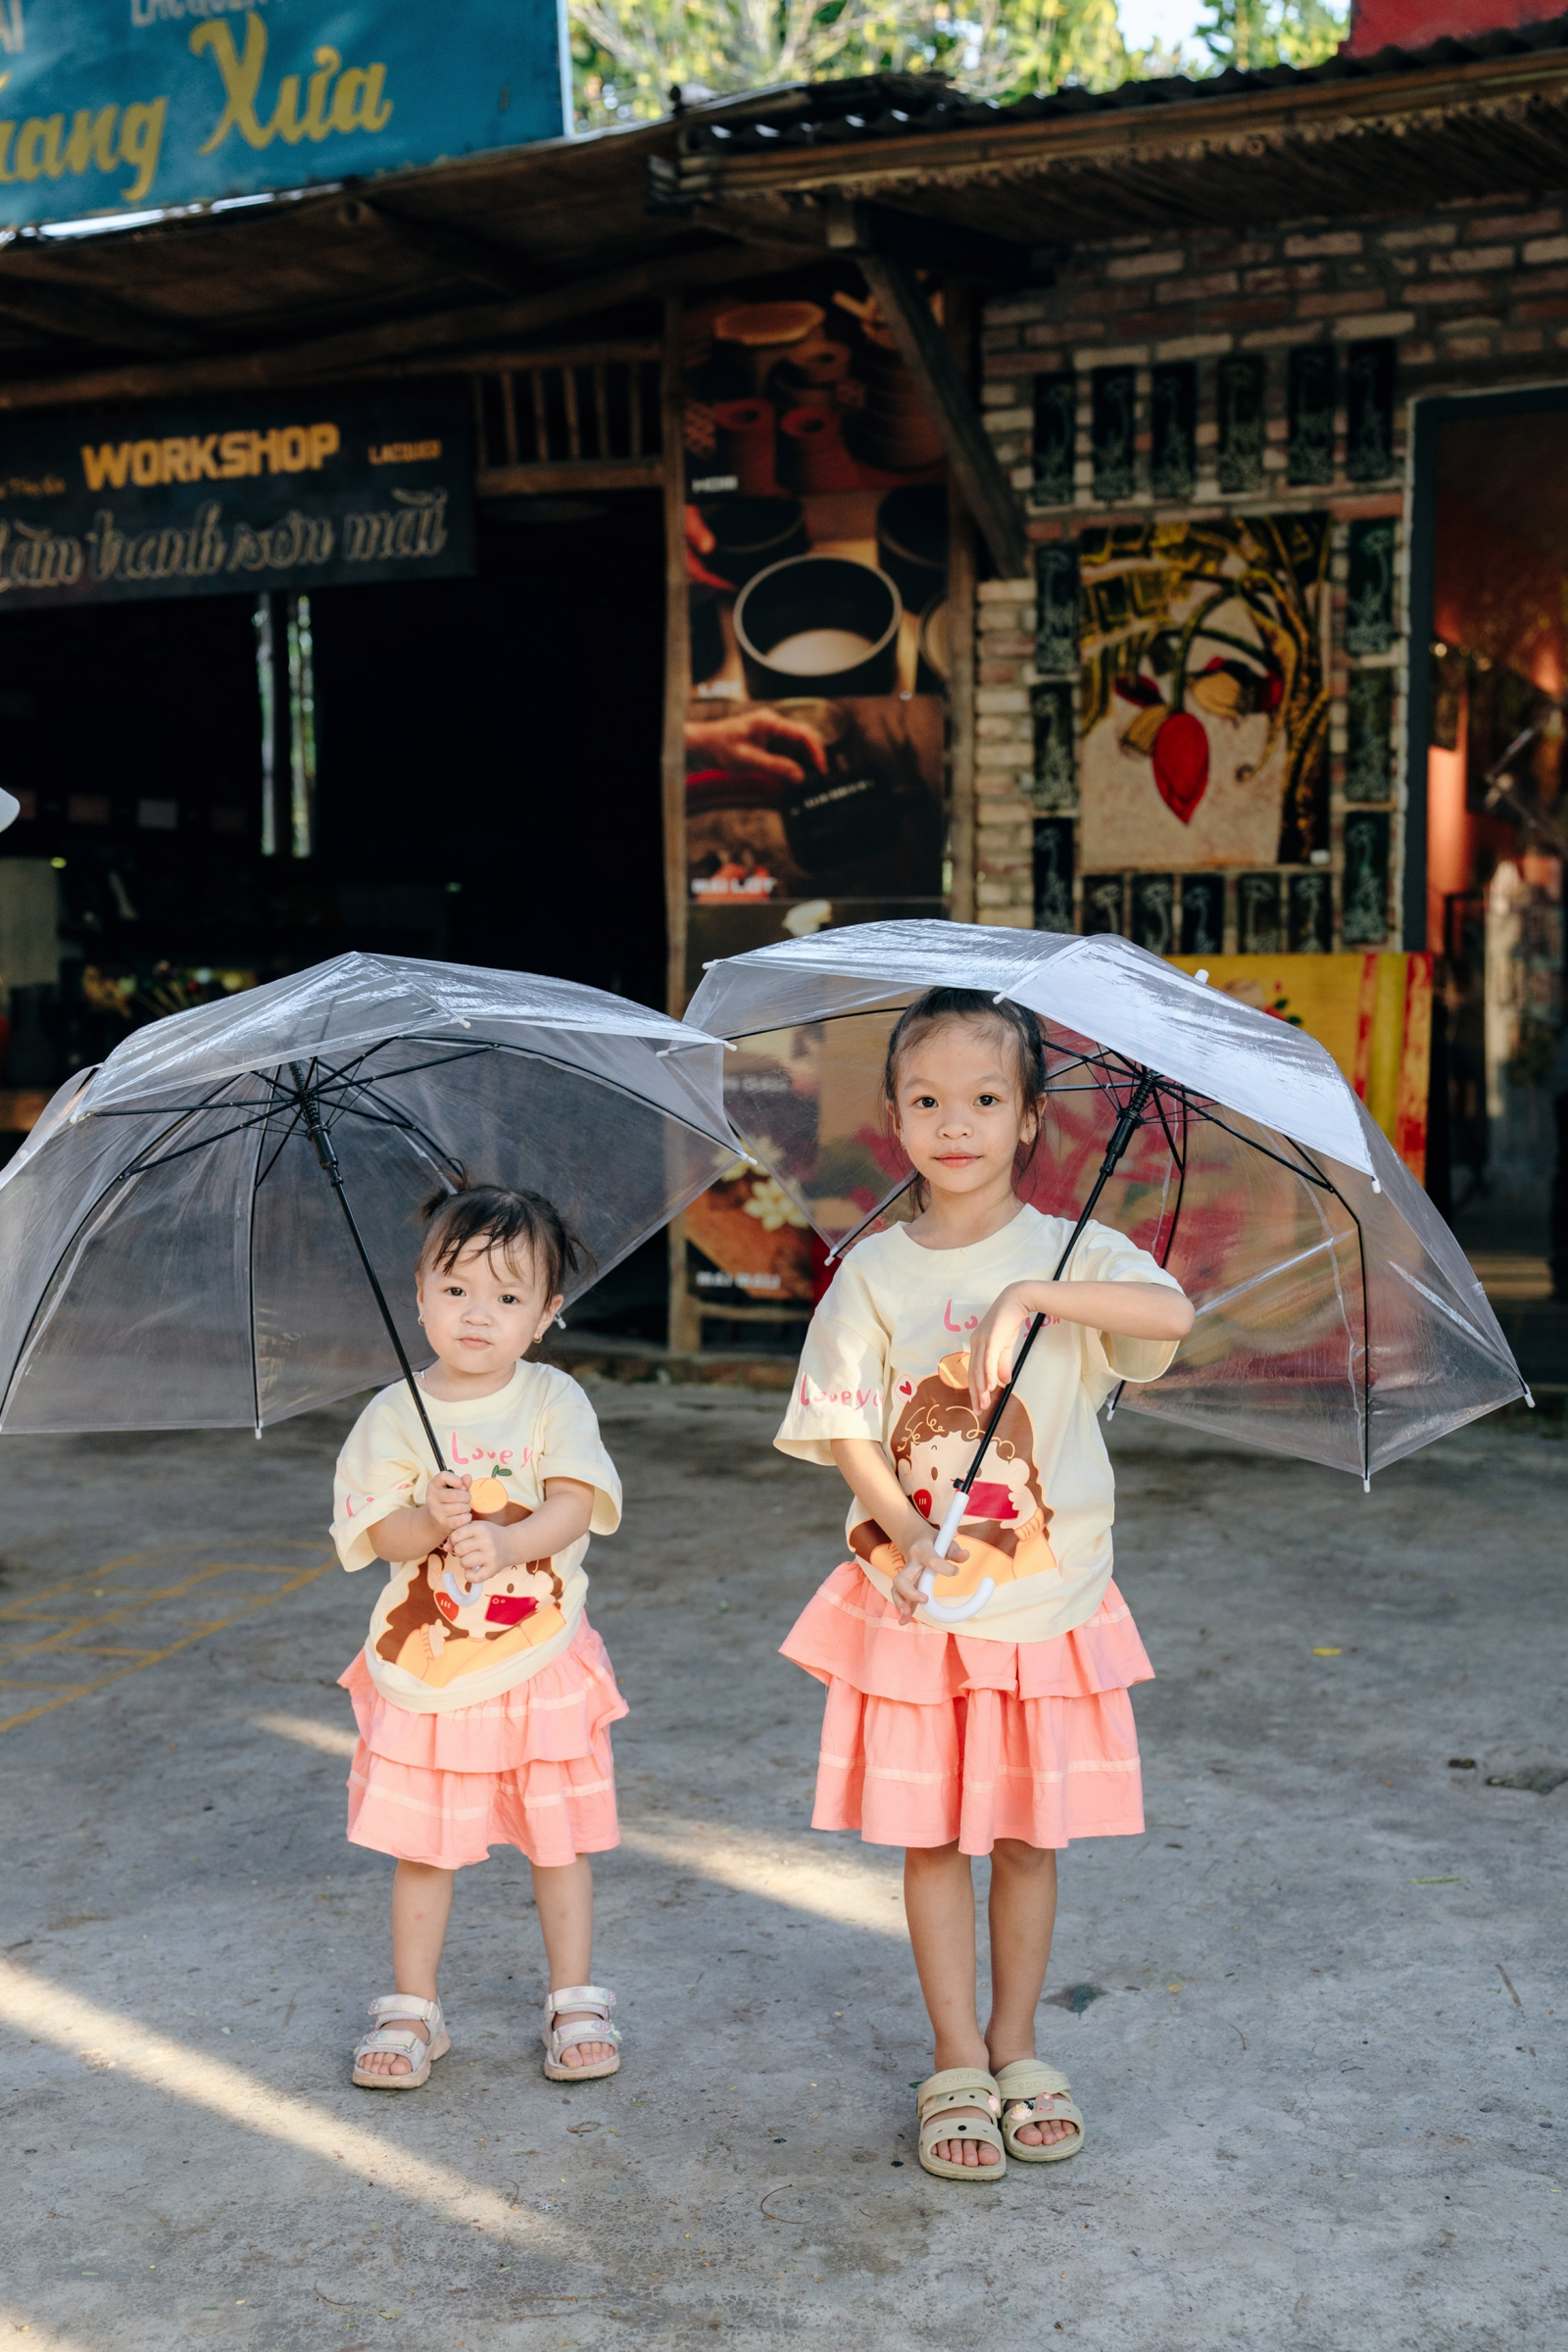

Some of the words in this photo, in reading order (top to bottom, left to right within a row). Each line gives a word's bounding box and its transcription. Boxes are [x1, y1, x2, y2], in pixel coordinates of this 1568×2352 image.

[188, 10, 393, 156] Xưa
[80, 422, 340, 491] WORKSHOP
[451, 1431, 514, 1466] Love
